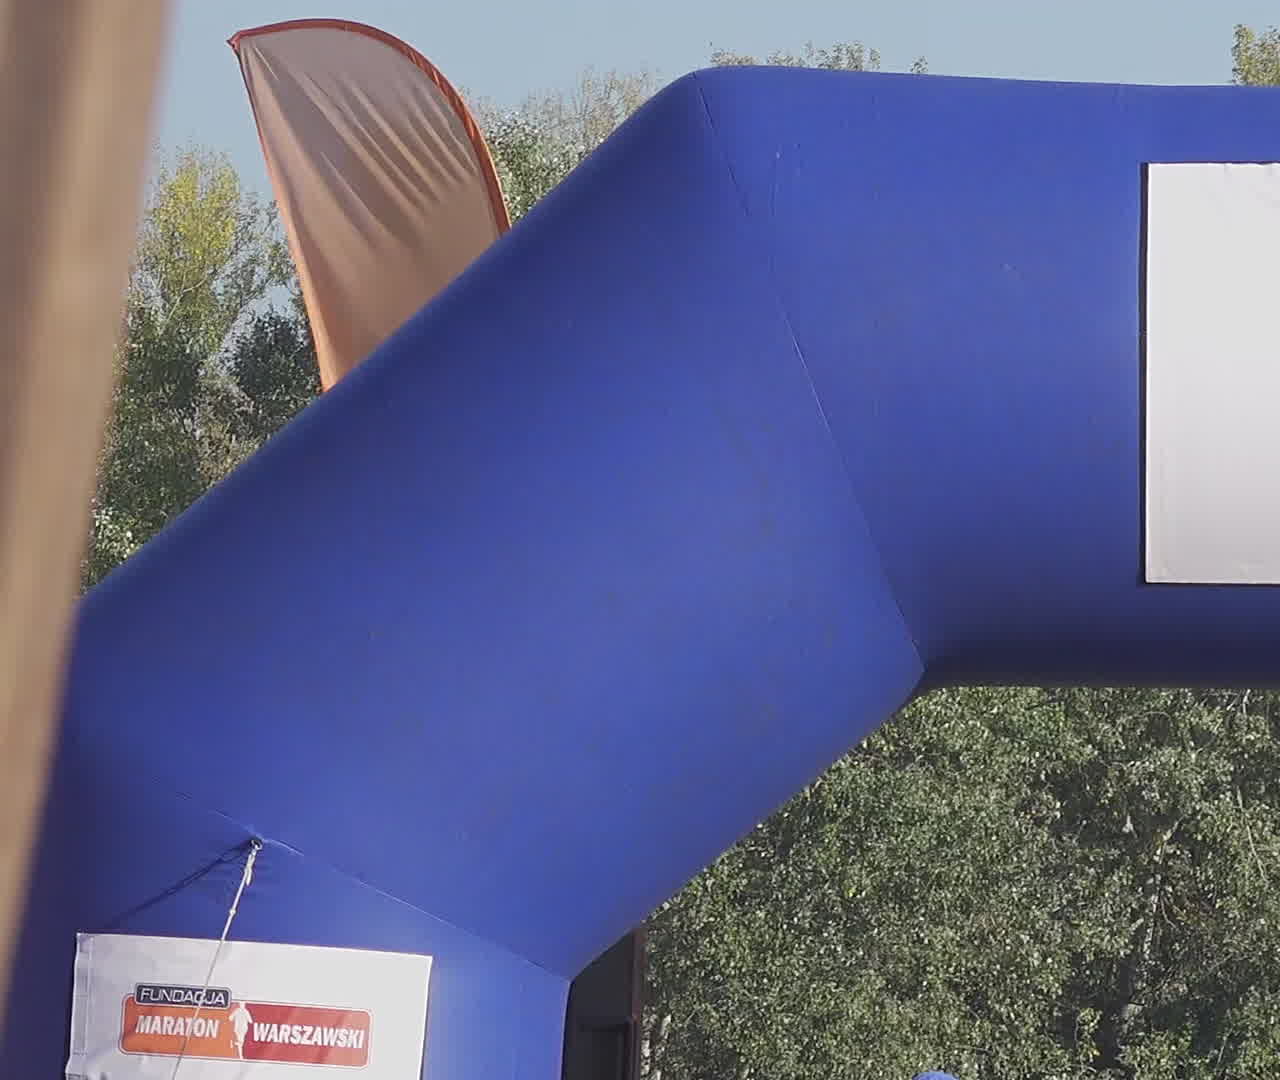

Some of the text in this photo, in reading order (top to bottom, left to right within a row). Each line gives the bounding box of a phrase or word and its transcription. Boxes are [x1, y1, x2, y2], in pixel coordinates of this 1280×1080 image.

[140, 987, 226, 1006] FUNDACJA
[135, 1015, 365, 1049] MARATON WARSZAWSKI
